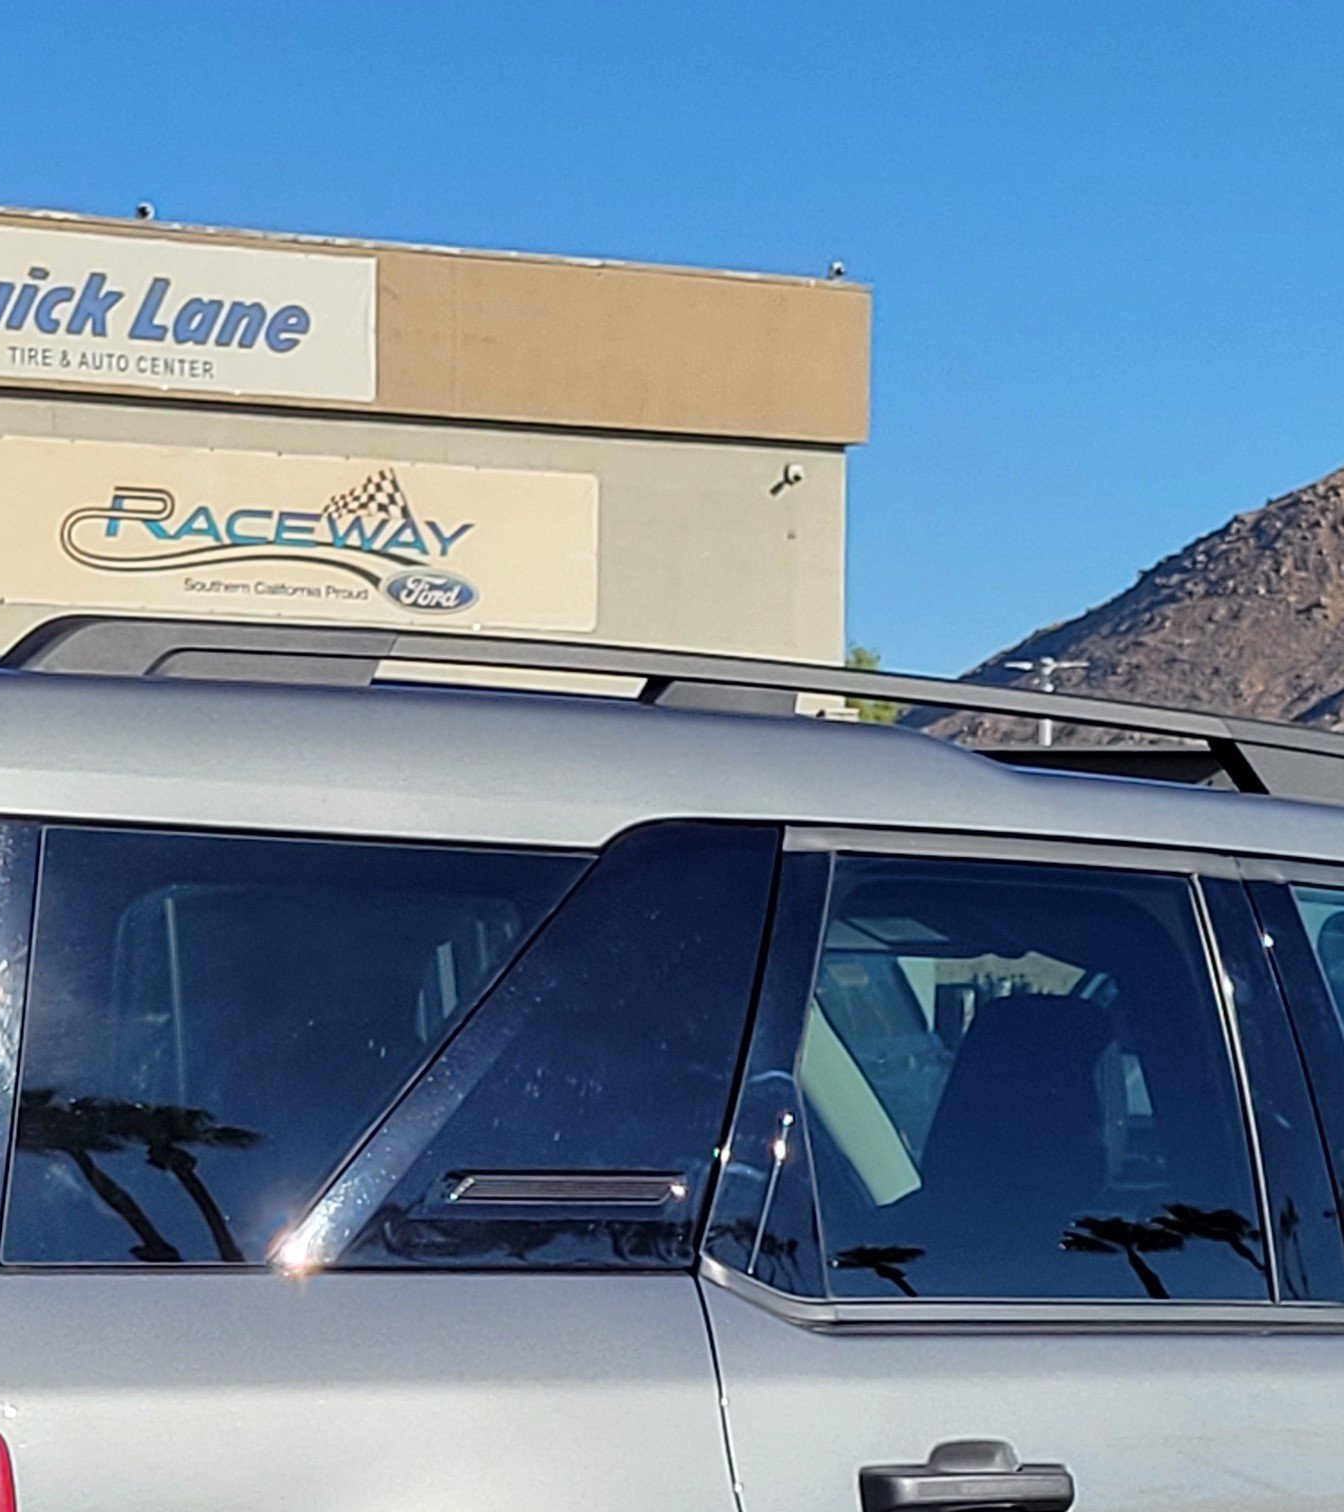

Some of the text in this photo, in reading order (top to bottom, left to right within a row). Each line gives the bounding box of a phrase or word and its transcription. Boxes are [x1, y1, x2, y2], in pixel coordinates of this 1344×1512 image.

[128, 277, 312, 353] Lane
[8, 346, 215, 380] TIRE & AUTO CENTER
[183, 577, 369, 602] Southern California Proud
[399, 575, 462, 609] Ford
